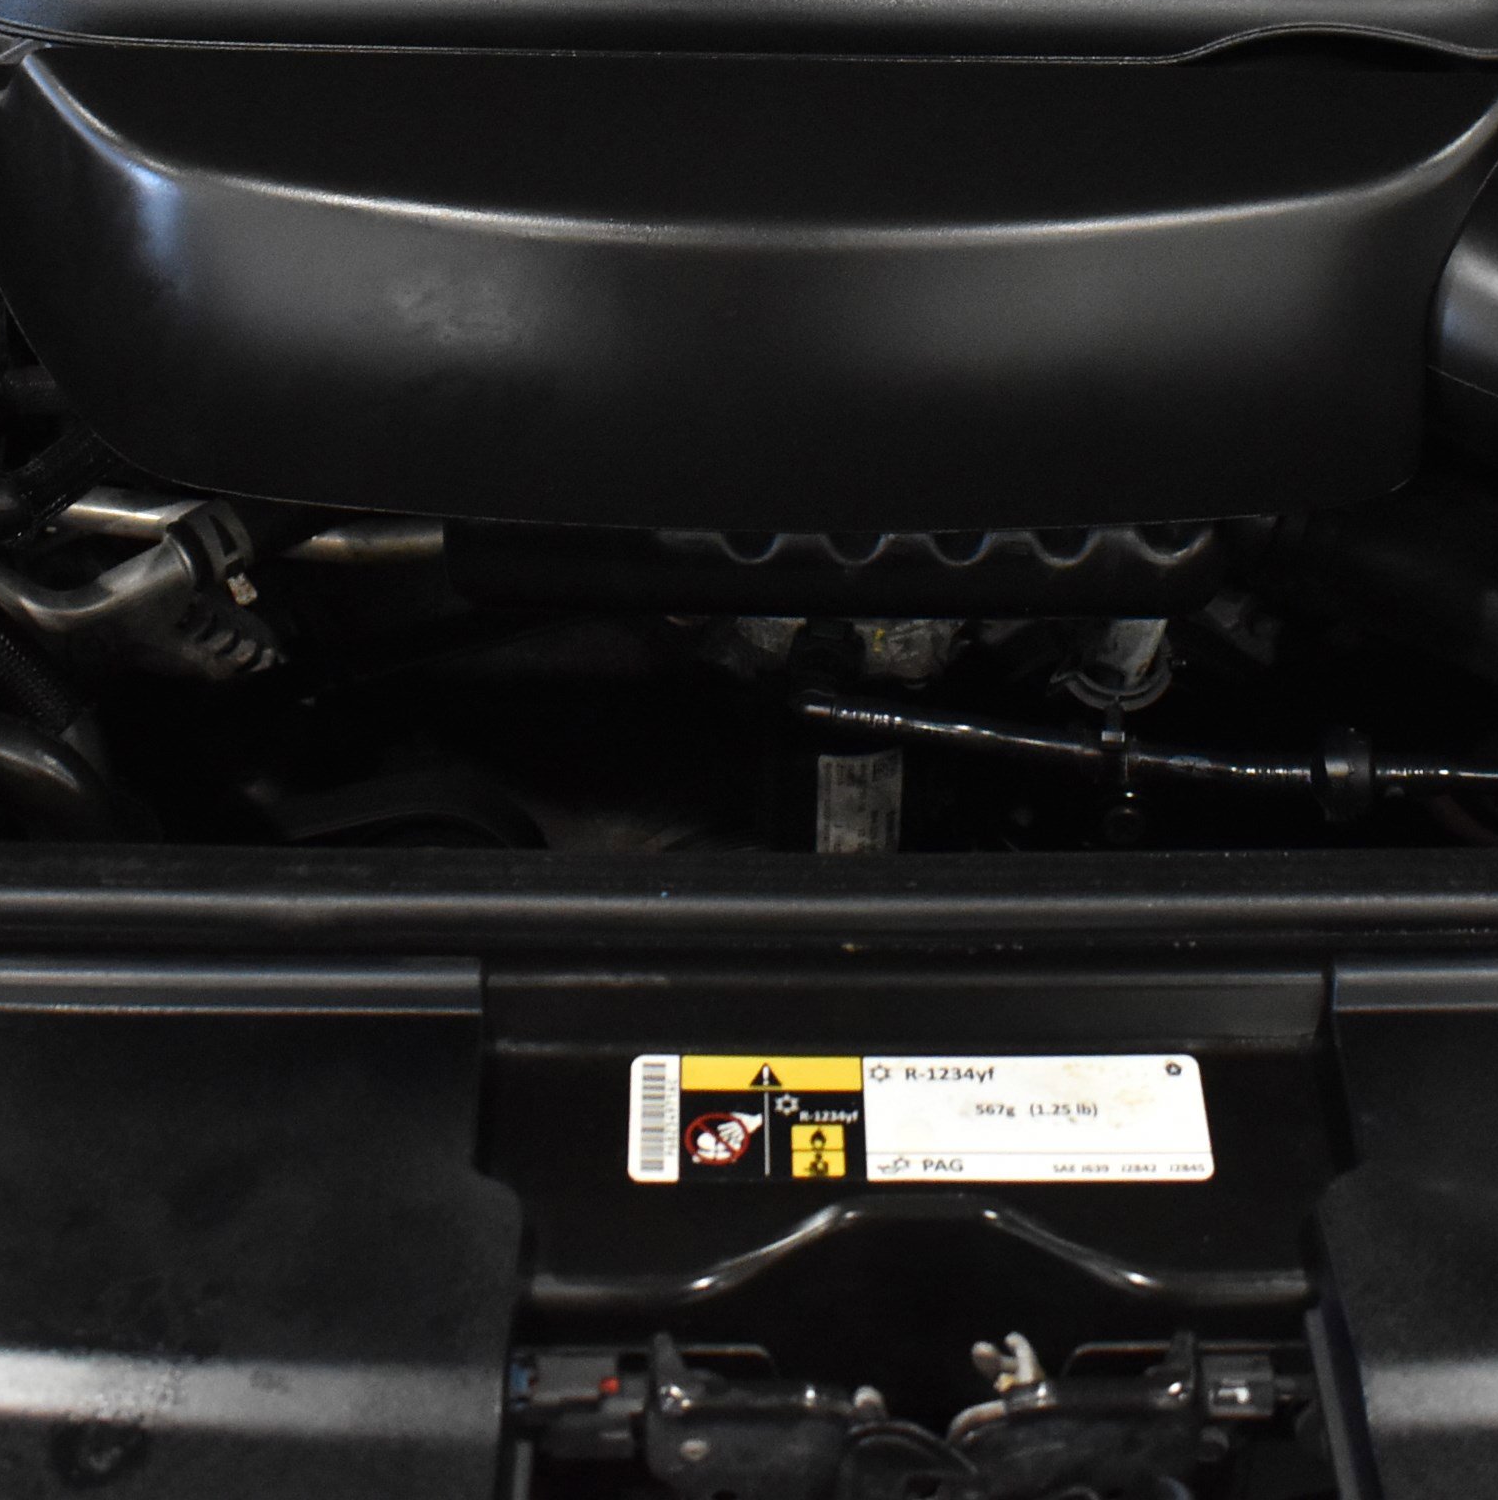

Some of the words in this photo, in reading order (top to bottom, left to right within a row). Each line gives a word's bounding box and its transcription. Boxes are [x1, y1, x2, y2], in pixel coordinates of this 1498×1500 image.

[904, 1066, 995, 1084] R-1234yf
[799, 1109, 859, 1124] R-1234yf
[974, 1103, 1016, 1118] 567g
[921, 1158, 964, 1173] PAG
